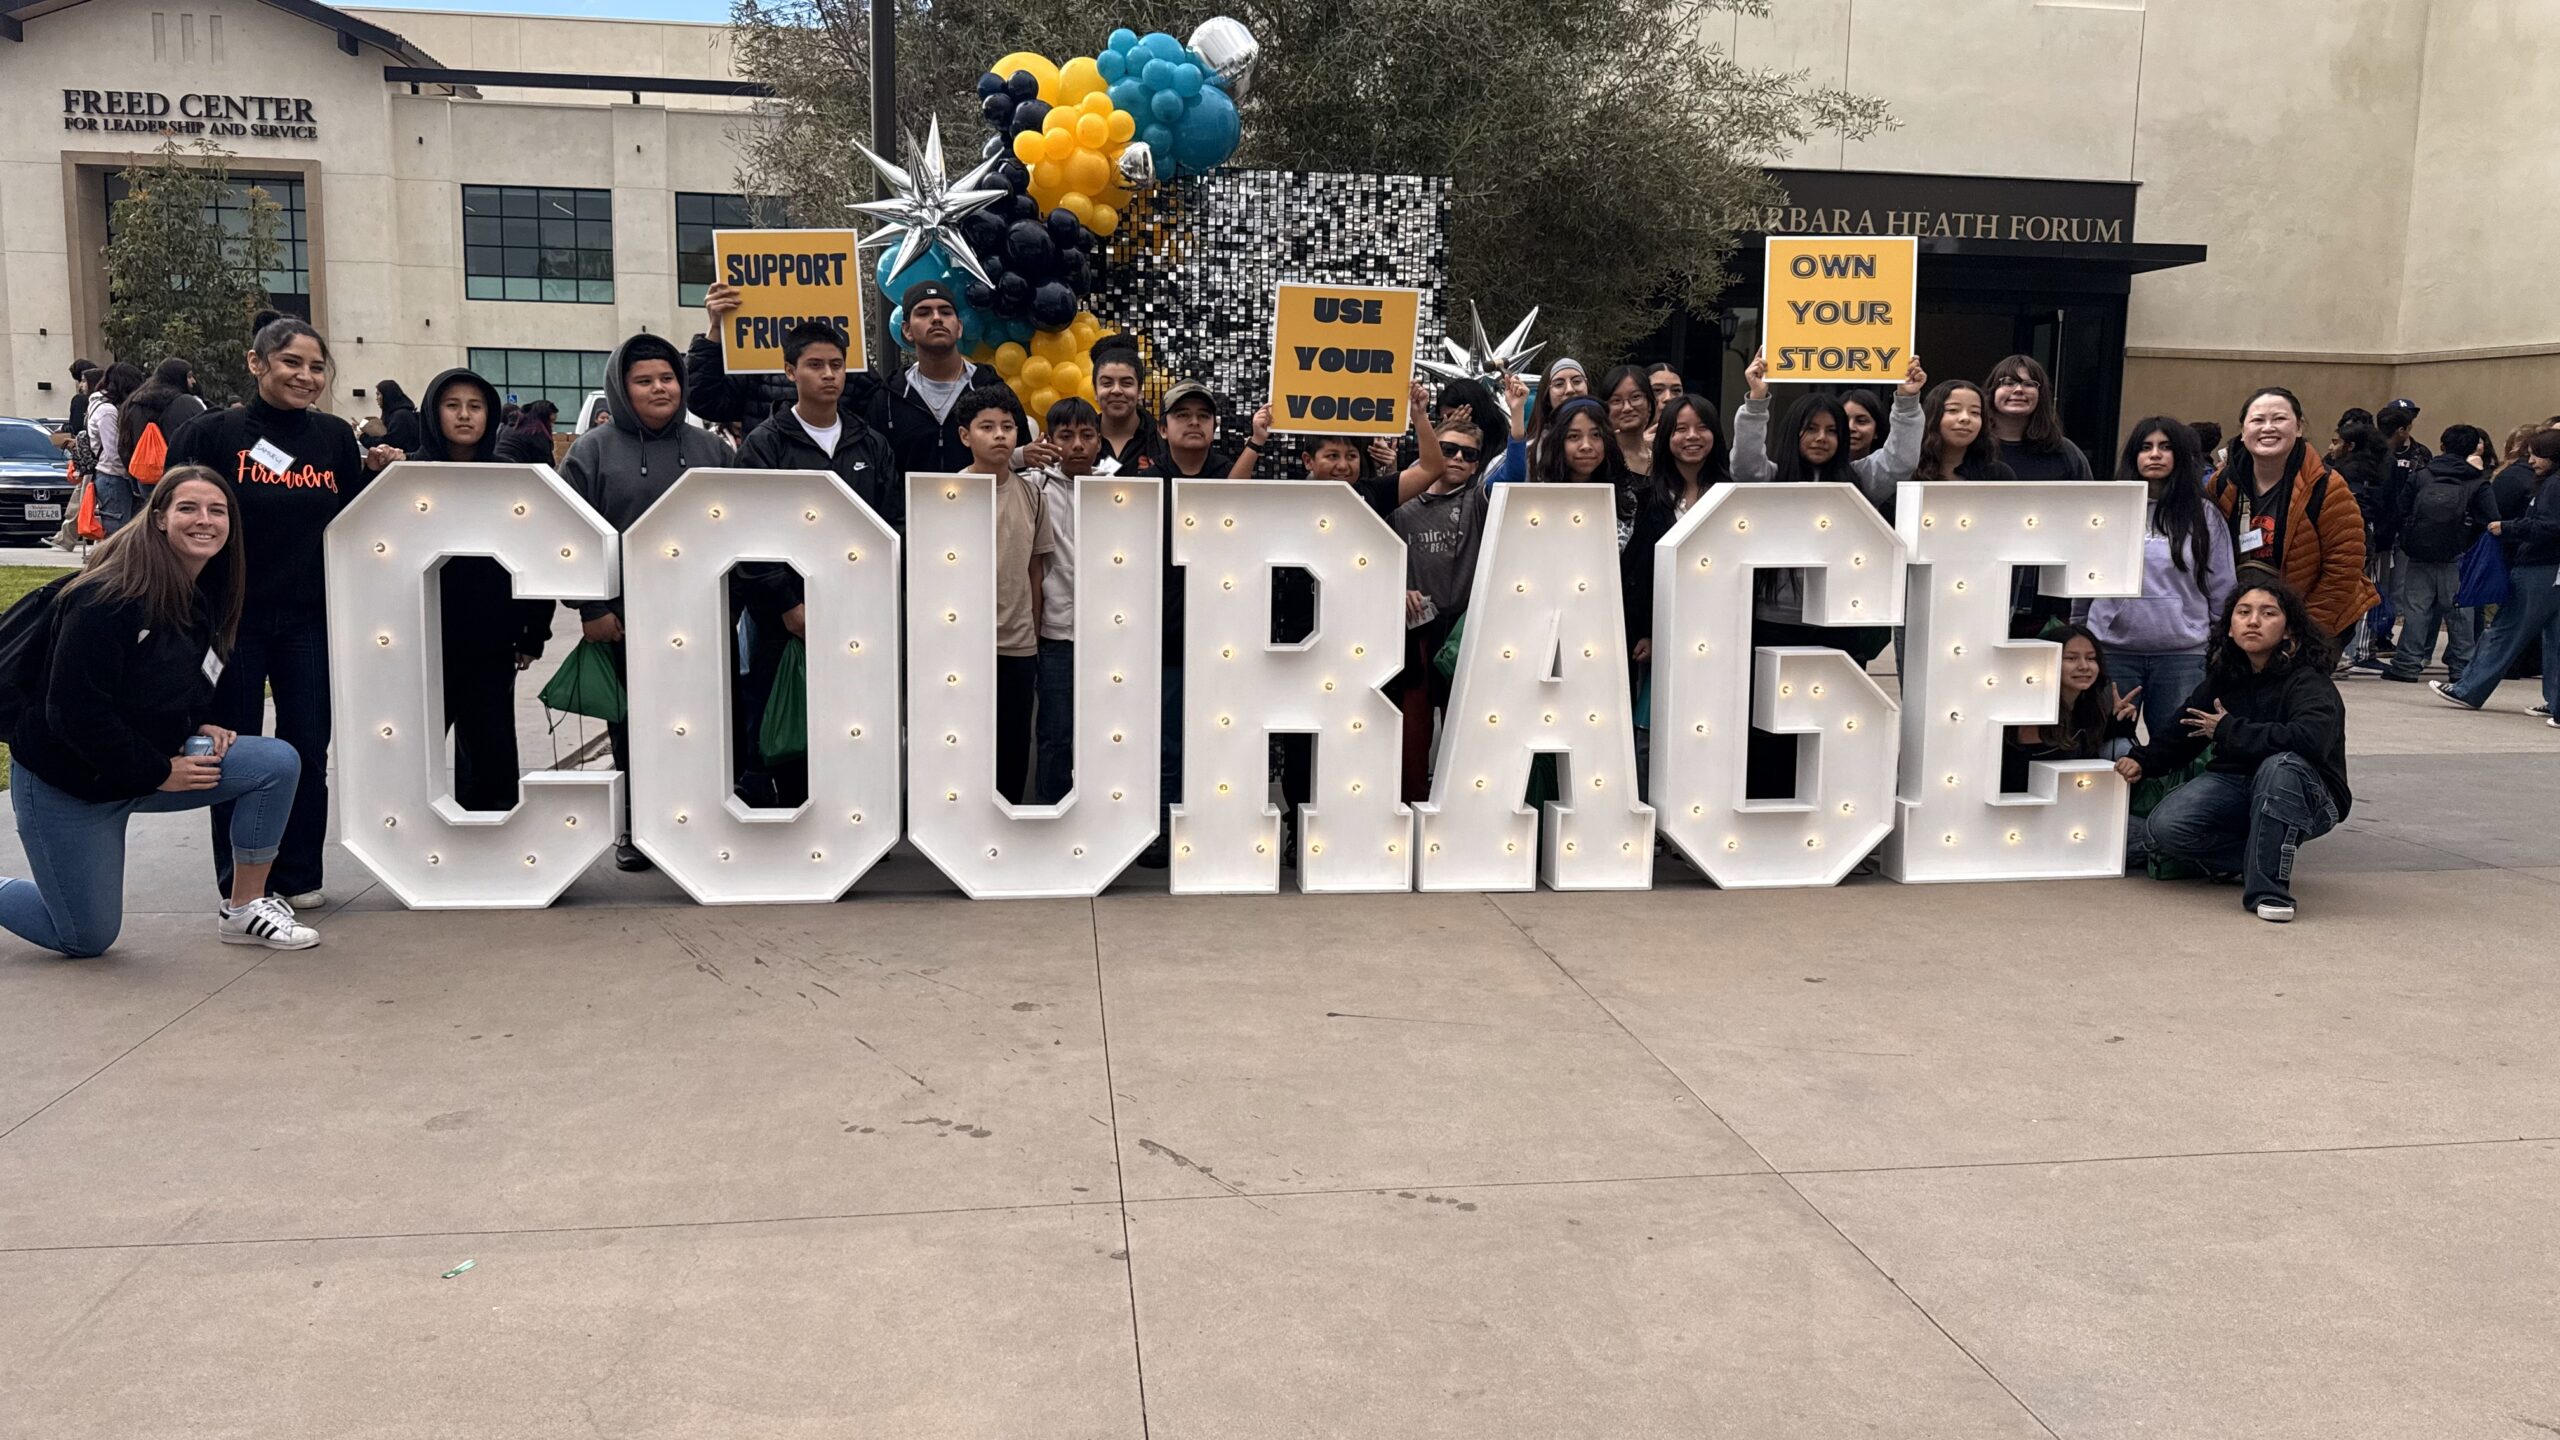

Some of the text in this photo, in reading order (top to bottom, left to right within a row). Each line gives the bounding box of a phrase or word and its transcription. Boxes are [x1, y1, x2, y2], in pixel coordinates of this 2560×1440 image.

[62, 89, 317, 123] FREED CENTER
[64, 117, 317, 139] FOR LEADERSHIP AND SERVICE
[1884, 210, 1999, 239] HEATH
[2008, 215, 2123, 244] FORUM
[726, 252, 847, 287] SUPPORT
[1790, 254, 1877, 279] OWN
[1313, 297, 1383, 325] USE
[1787, 300, 1893, 325] YOUR
[735, 315, 850, 349] FRIES
[1294, 346, 1395, 374] YOUR
[1776, 346, 1901, 371] STORY
[1286, 394, 1395, 422] VOICE
[237, 449, 338, 494] Firewolves
[325, 461, 2149, 910] COURAGE
